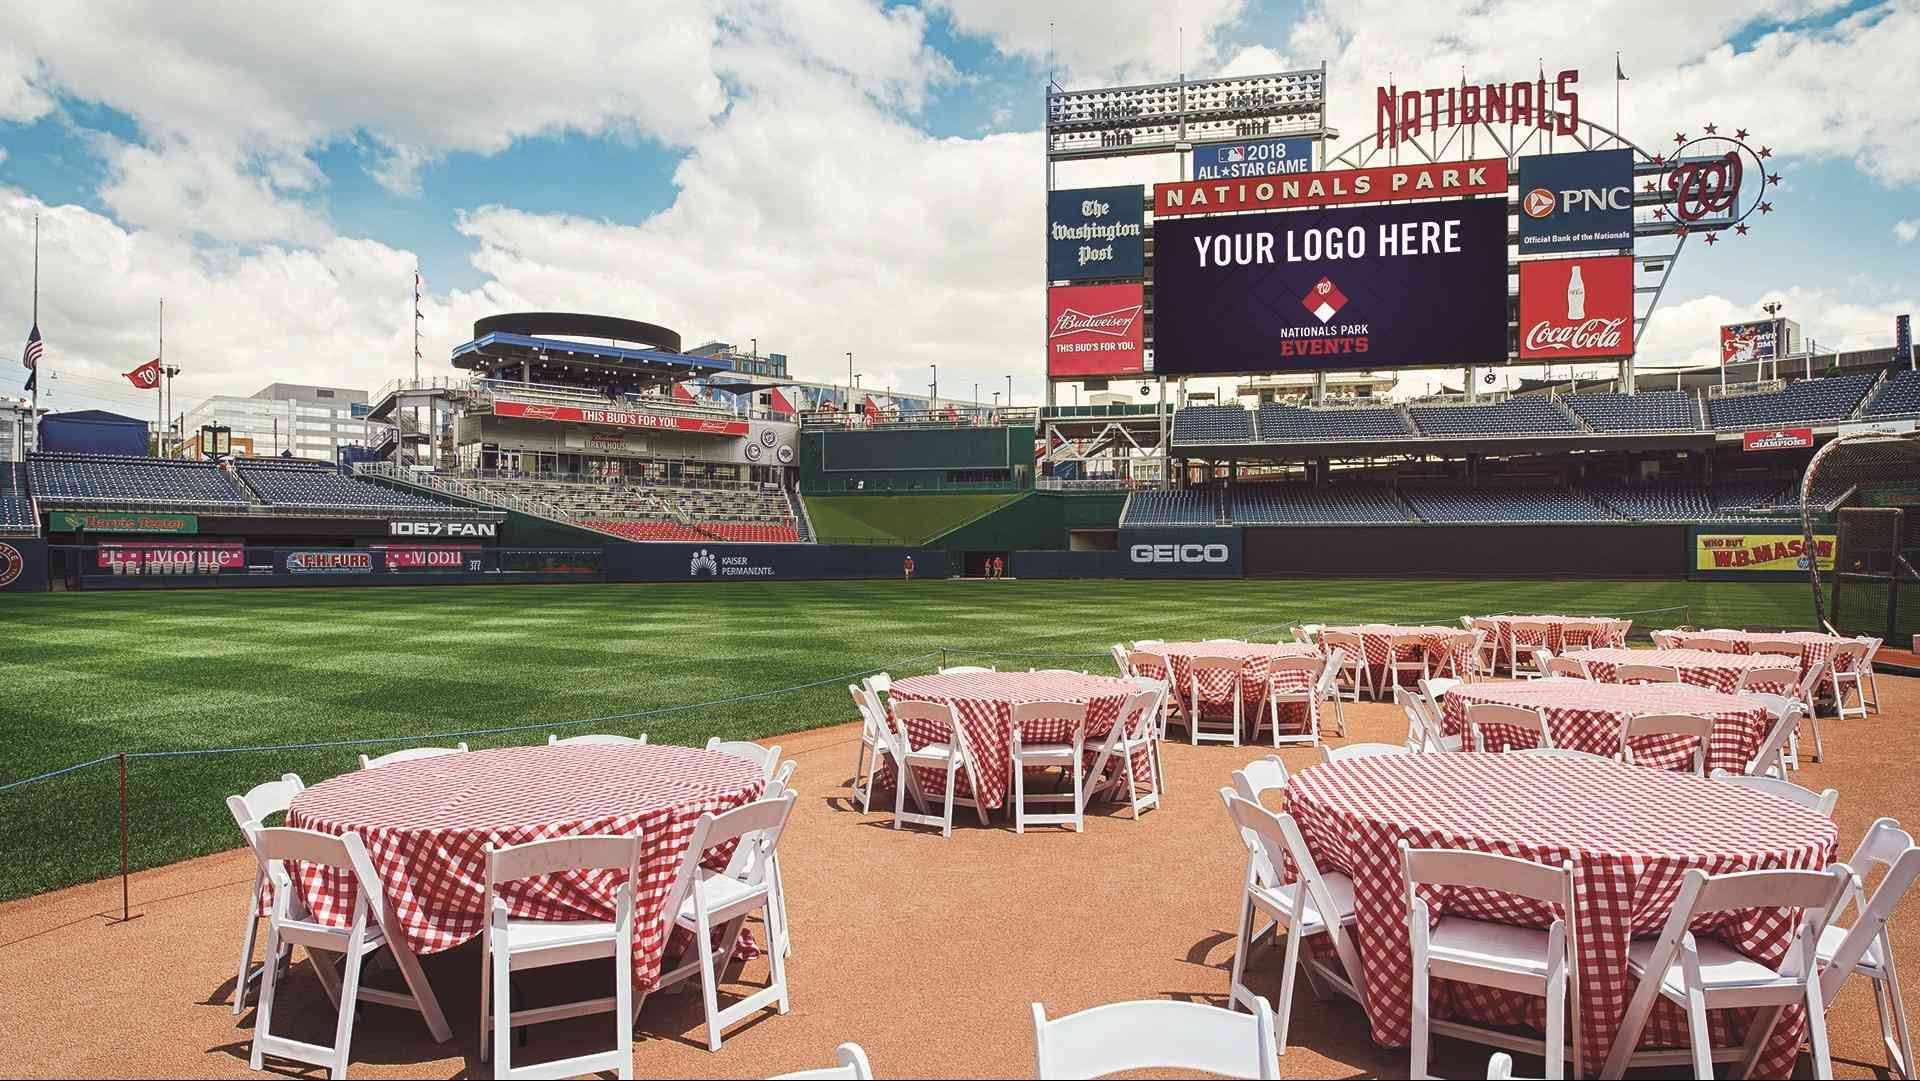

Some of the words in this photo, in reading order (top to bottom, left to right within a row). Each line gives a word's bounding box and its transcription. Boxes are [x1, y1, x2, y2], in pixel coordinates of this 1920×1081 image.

[1377, 70, 1578, 149] NATIONALS
[1247, 143, 1286, 160] 2018
[1199, 166, 1221, 180] ALL
[1231, 162, 1264, 178] STAR
[1268, 159, 1307, 174] GAME
[1167, 175, 1372, 207] NATIONALS
[1392, 167, 1487, 191] PARK
[1082, 200, 1110, 217] The
[1560, 187, 1631, 213] PNC
[1052, 221, 1140, 241] Washington
[1524, 236, 1550, 244] Official
[1552, 234, 1571, 242] Bank
[1573, 233, 1580, 241] of
[1594, 231, 1630, 240] Nationals
[1194, 232, 1274, 267] YOUR
[1287, 226, 1366, 262] LOGO
[1379, 220, 1461, 256] HERE
[1078, 244, 1113, 266] Post
[1057, 315, 1131, 329] Budweiser
[1280, 326, 1337, 338] NATIONALS
[1341, 324, 1369, 335] PARK
[1526, 316, 1627, 350] Coca-Cola
[1056, 343, 1074, 353] THIS
[1075, 343, 1099, 352] BUD'S
[1101, 342, 1116, 351] FOR
[1118, 341, 1136, 350] YOU.
[1280, 337, 1369, 356] EVENTS
[582, 411, 606, 422] THIS
[608, 412, 636, 425] BUD'S
[638, 415, 657, 426] FOR
[659, 417, 680, 428] YOU.
[390, 522, 442, 536] 106.7
[447, 523, 495, 536] FAN
[722, 556, 748, 565] KAISER
[1130, 544, 1228, 562] GEICO
[470, 559, 481, 572] 377
[722, 567, 775, 576] PERMANENTE
